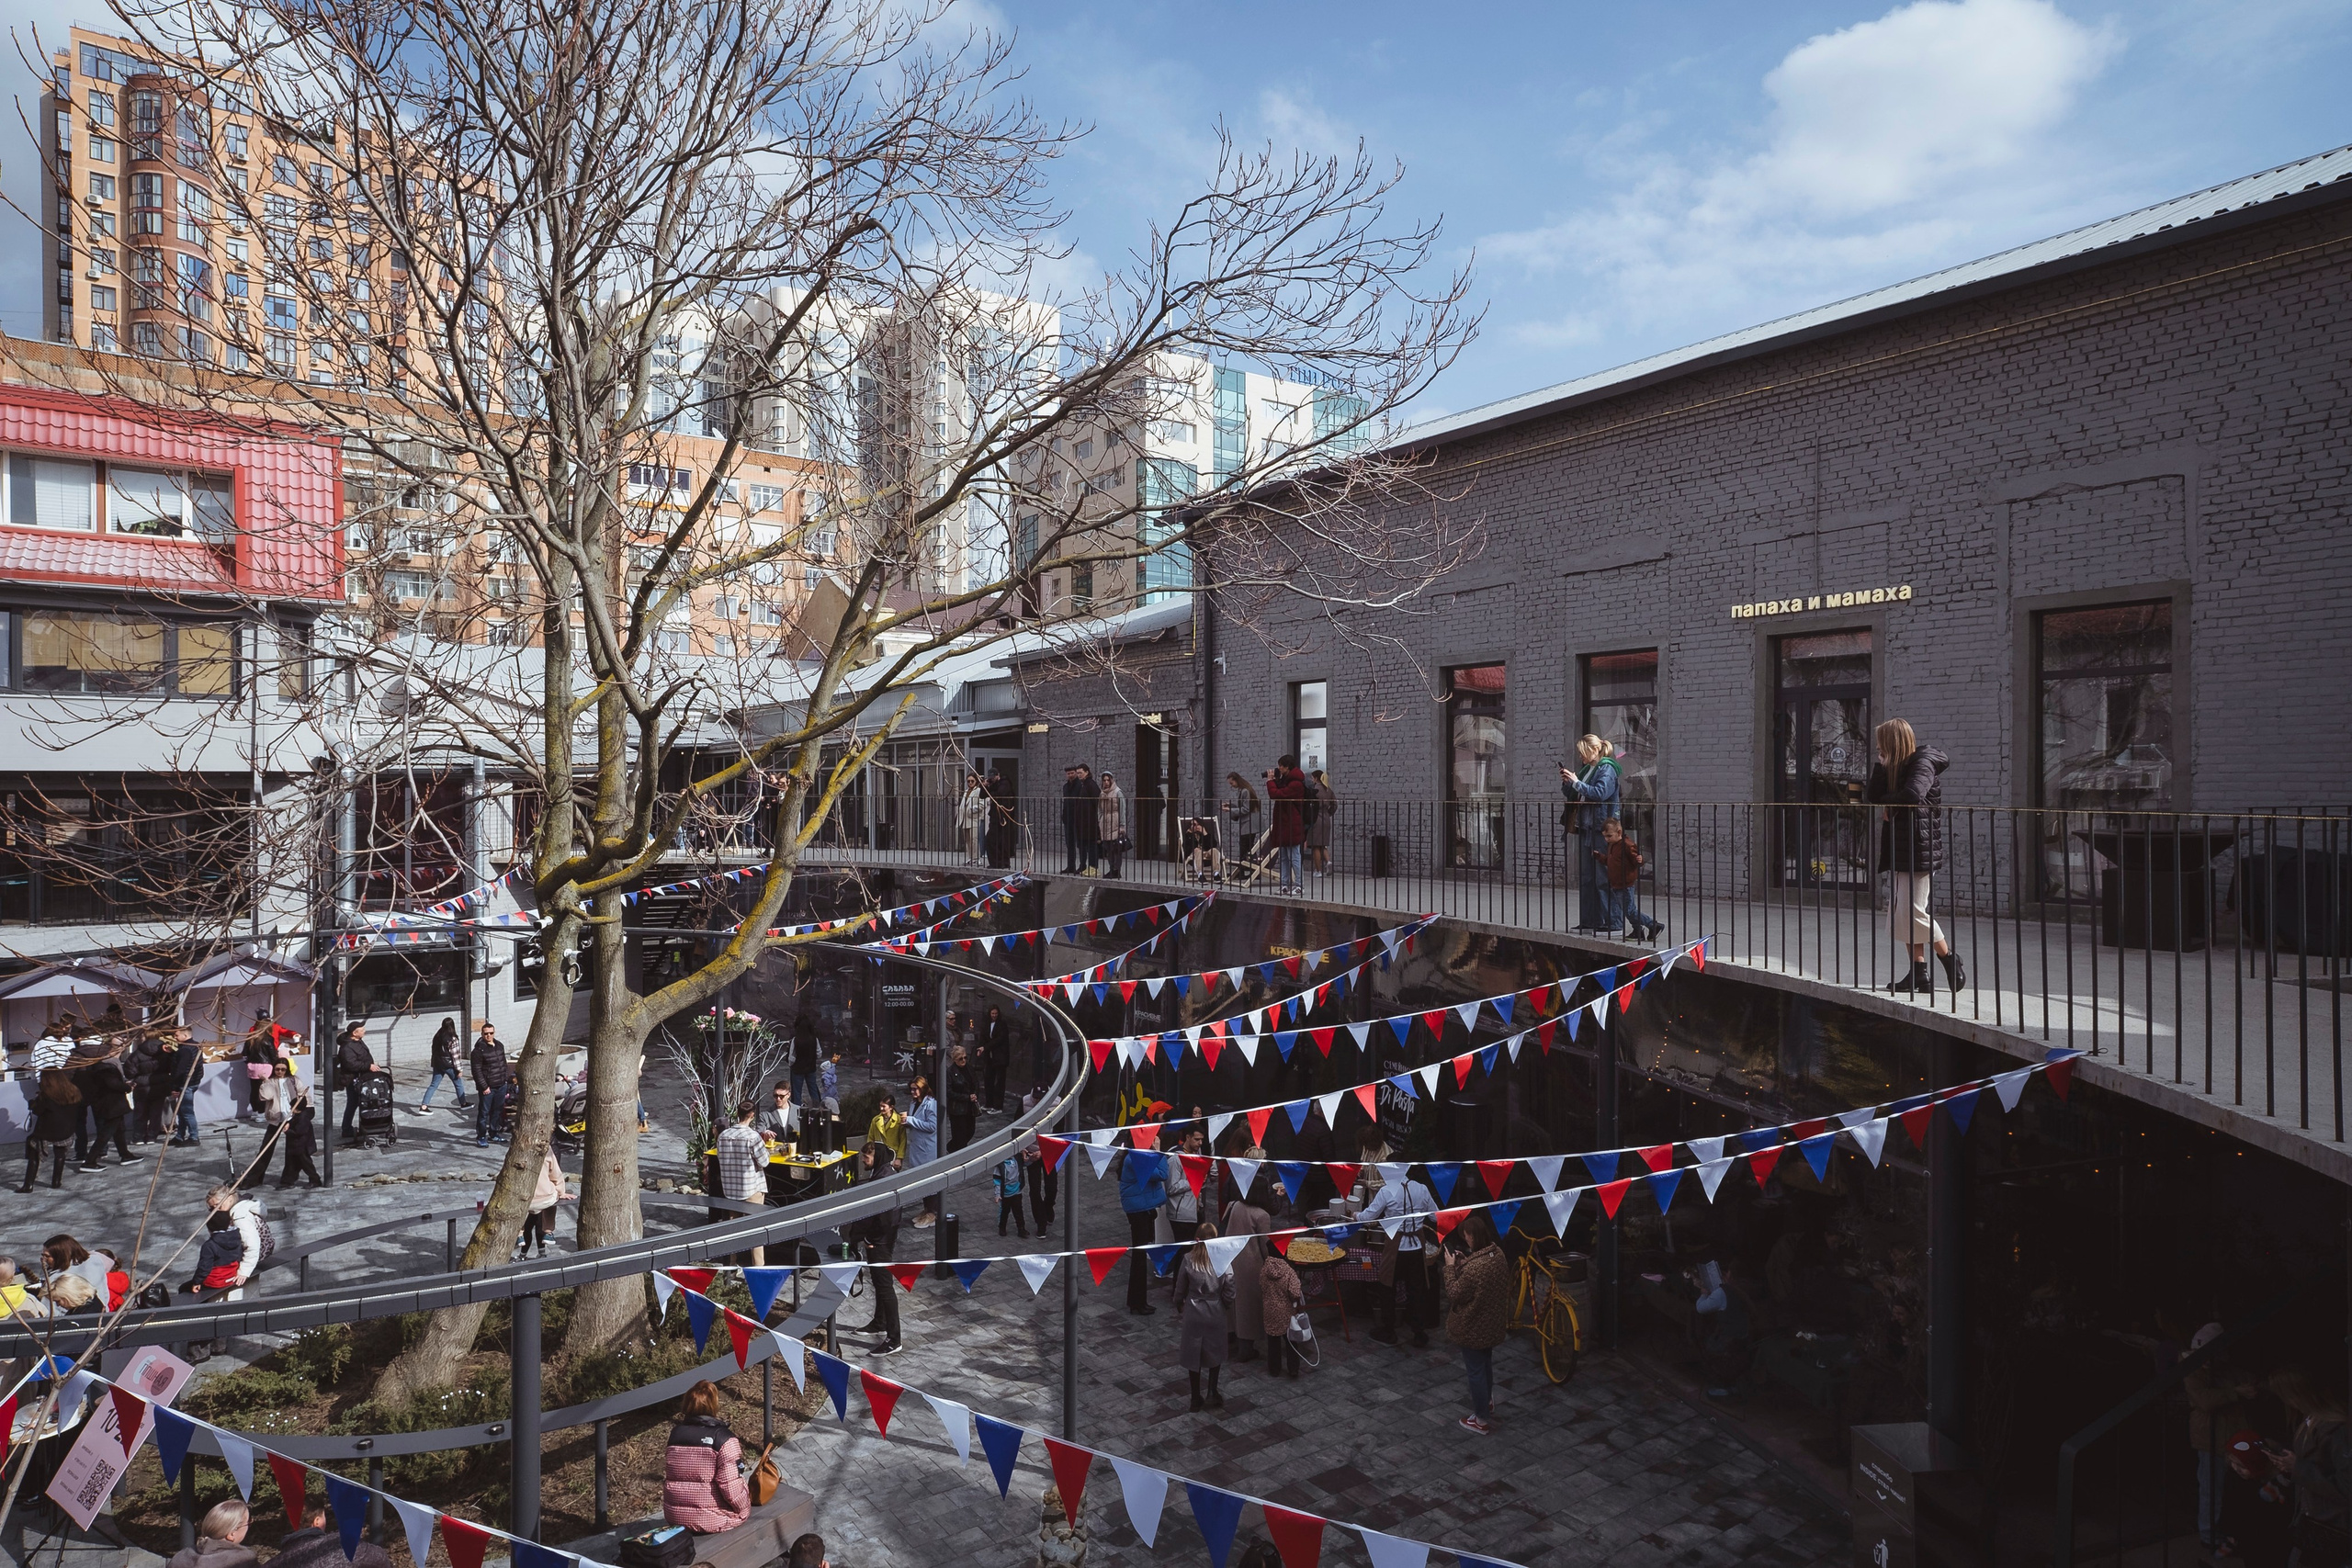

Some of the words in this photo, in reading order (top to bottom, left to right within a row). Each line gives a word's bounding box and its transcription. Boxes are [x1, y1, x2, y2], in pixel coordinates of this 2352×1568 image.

[1731, 598, 1803, 618] папаха
[1808, 596, 1821, 611] и
[1826, 584, 1912, 608] мамаха
[1270, 945, 1330, 964] КРАСИВЕ
[1380, 1084, 1391, 1106] Di
[1860, 1462, 1877, 1482] INSIDE
